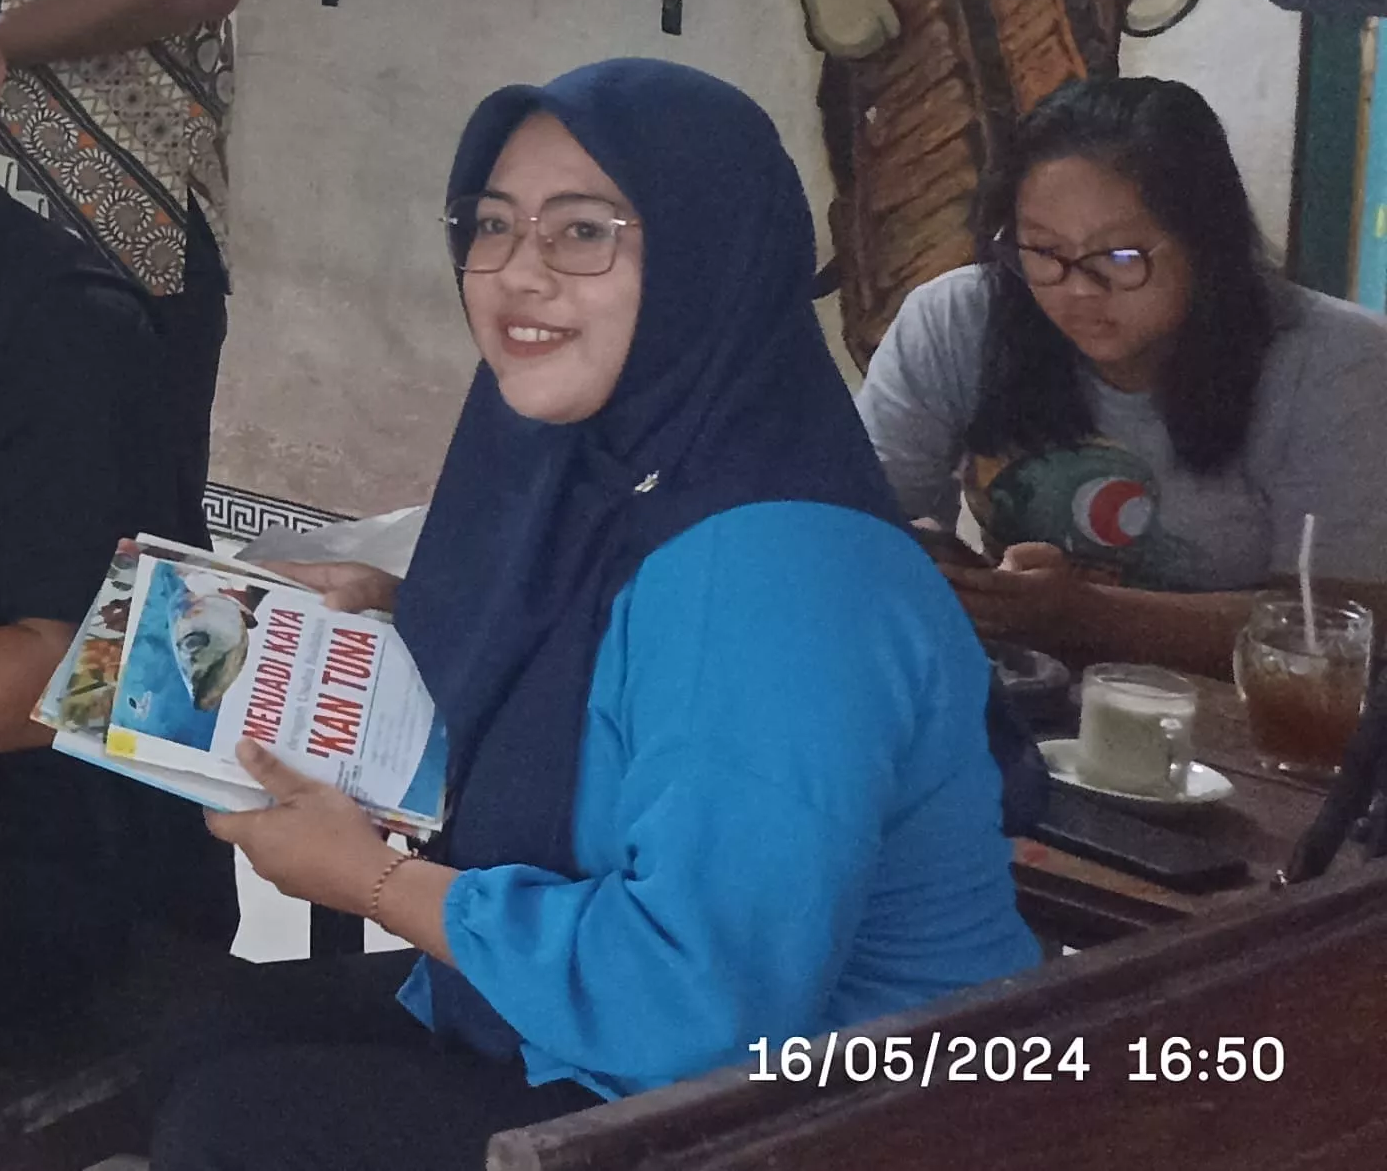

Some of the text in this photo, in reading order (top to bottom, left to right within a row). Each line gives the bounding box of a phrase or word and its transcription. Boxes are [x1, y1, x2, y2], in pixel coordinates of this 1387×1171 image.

[242, 608, 305, 744] MENJADI KAYA
[321, 628, 378, 691] TUNA
[306, 693, 363, 758] IKAN
